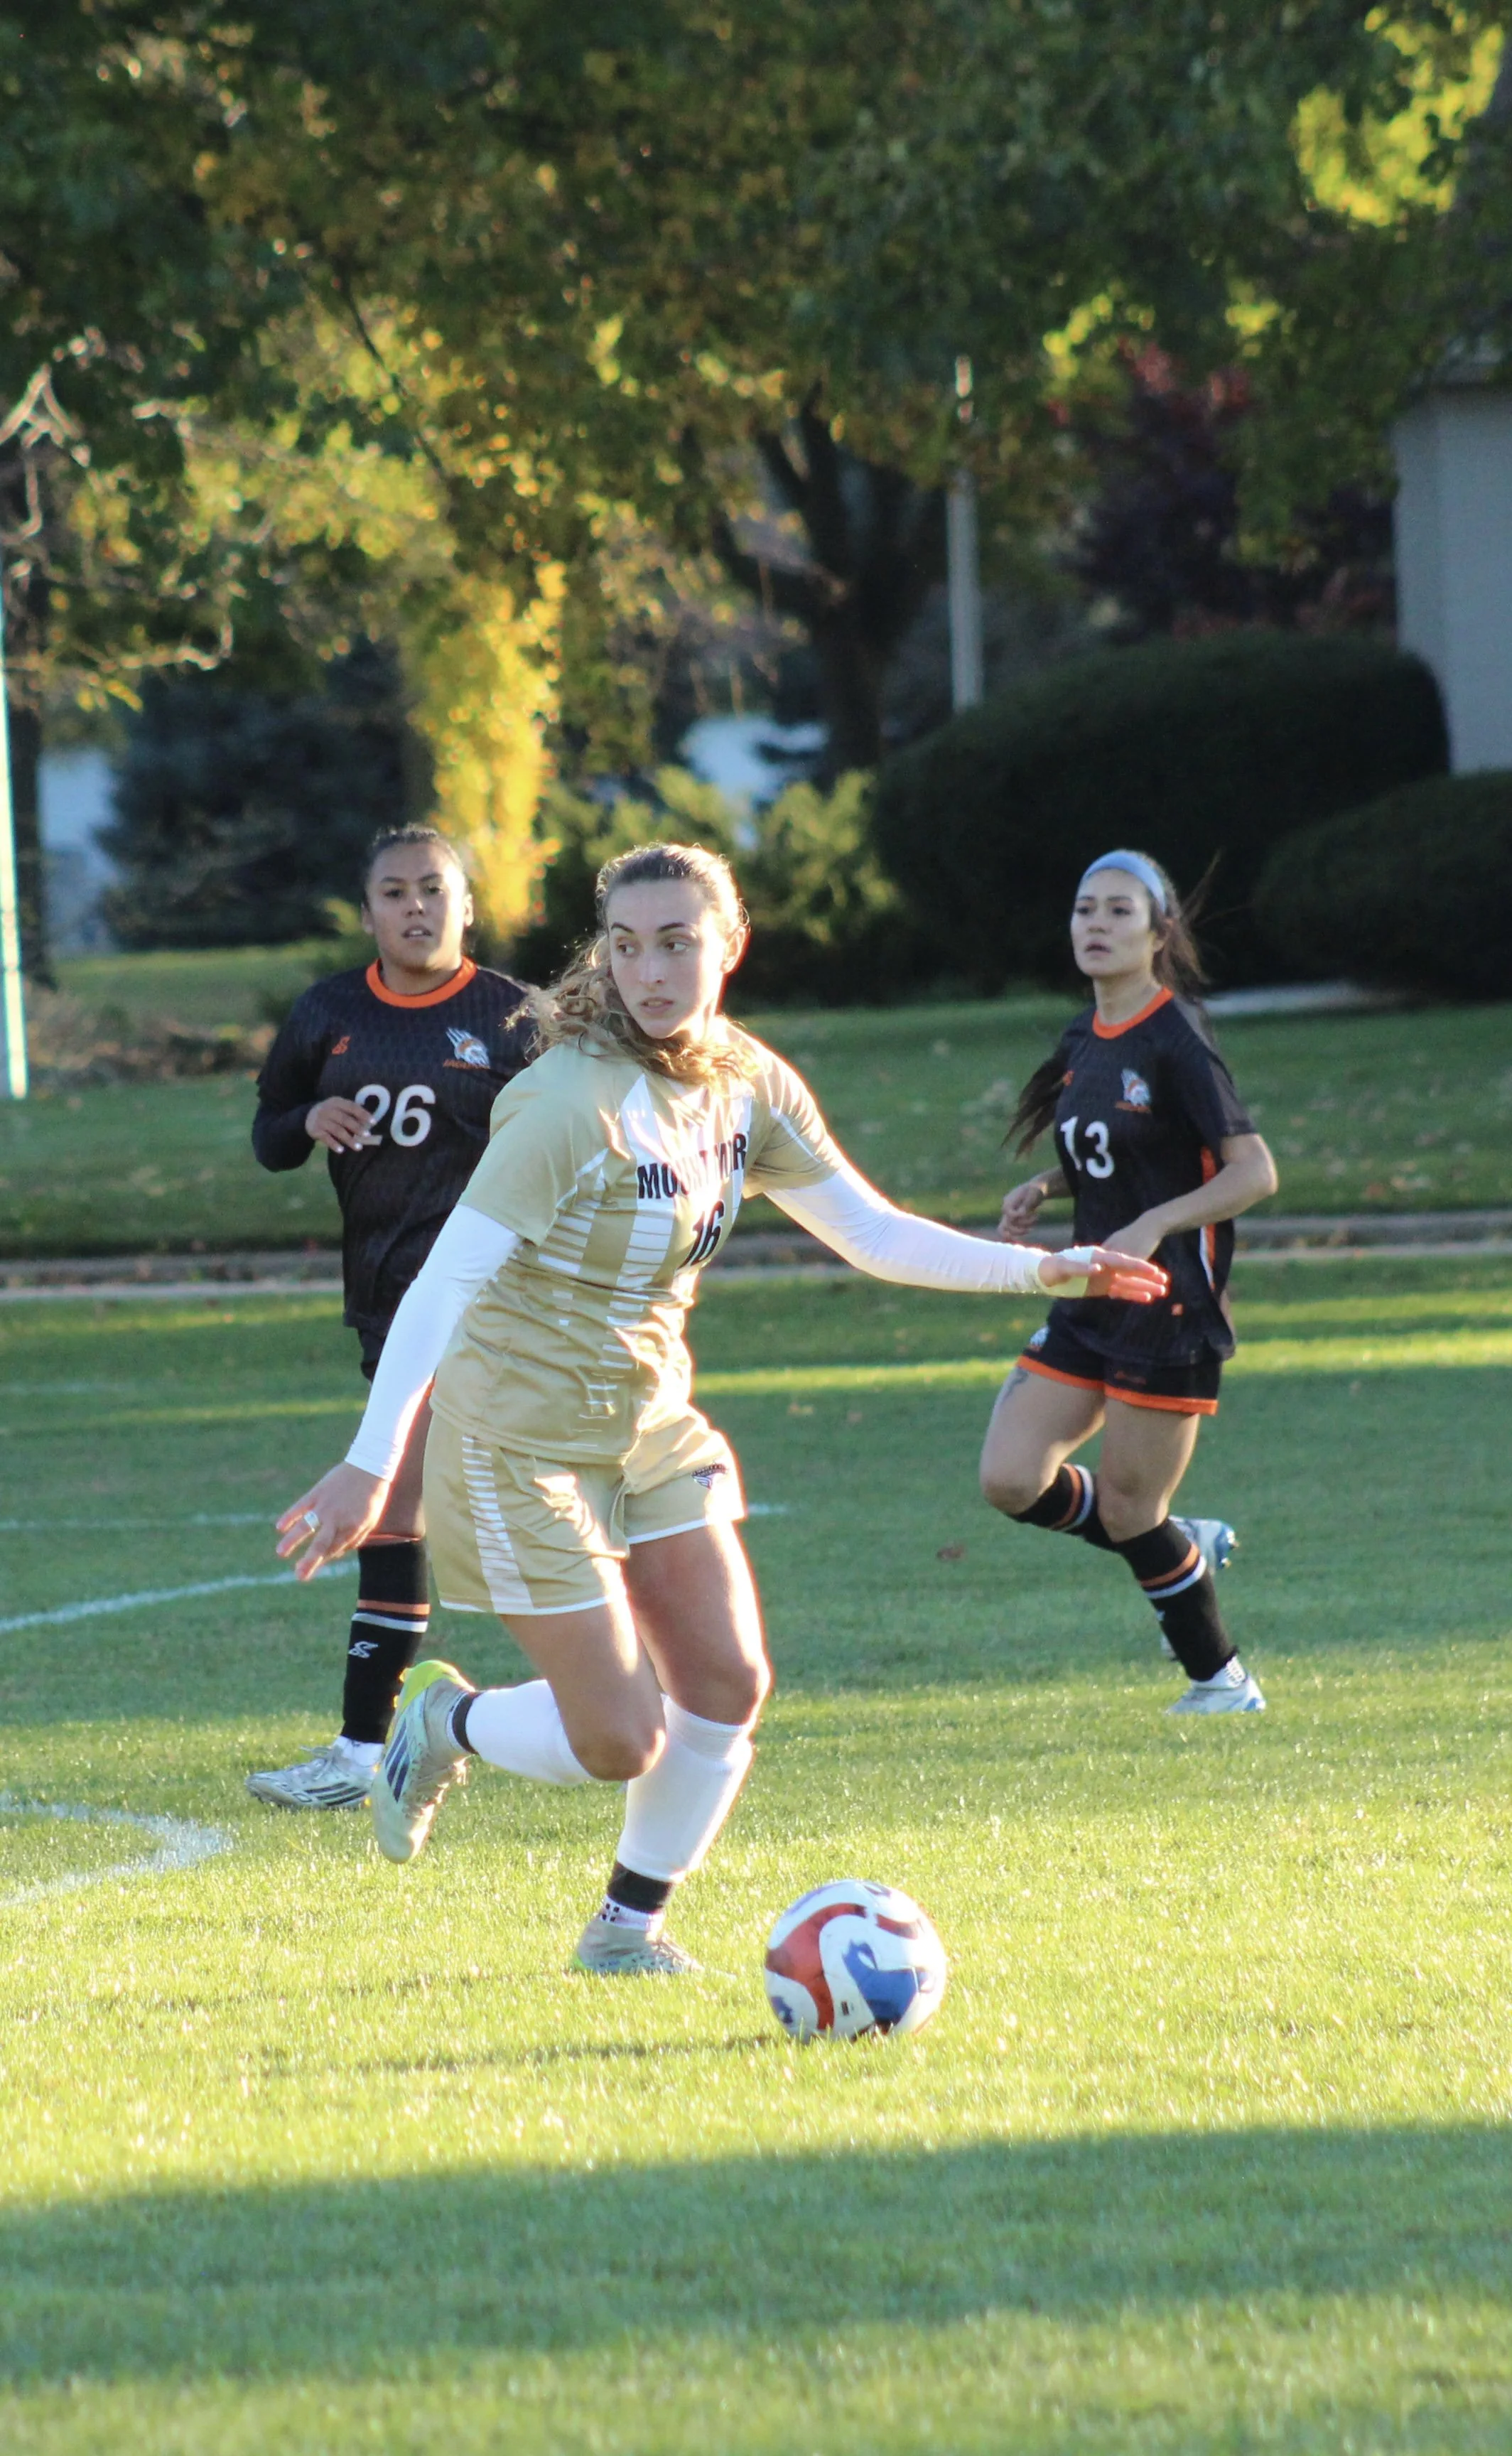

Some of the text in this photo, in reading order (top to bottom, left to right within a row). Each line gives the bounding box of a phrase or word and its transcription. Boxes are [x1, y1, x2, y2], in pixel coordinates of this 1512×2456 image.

[356, 1084, 436, 1146] 26
[1059, 1115, 1115, 1179] 13
[678, 1199, 725, 1269] 16
